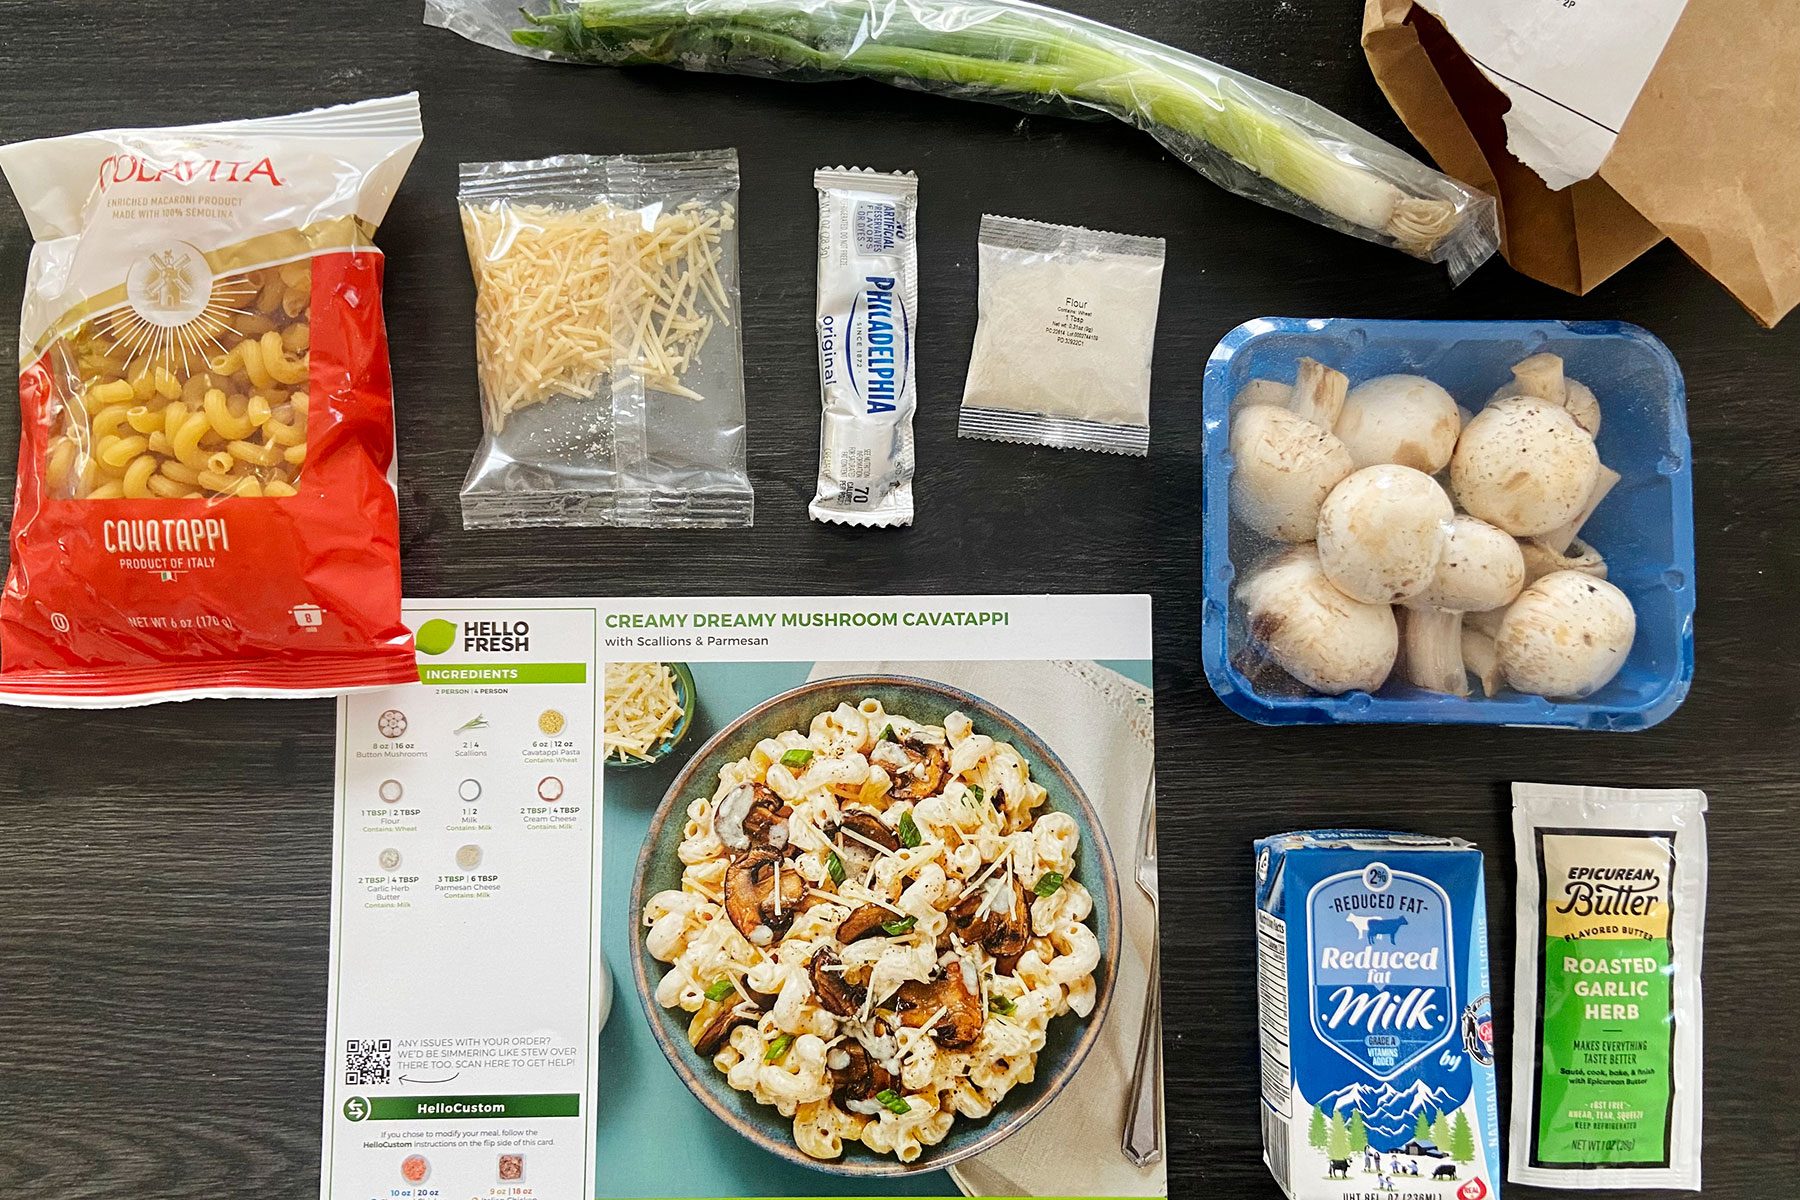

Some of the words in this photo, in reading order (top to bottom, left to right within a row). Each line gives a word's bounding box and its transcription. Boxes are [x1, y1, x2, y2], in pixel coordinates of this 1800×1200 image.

[1563, 0, 1576, 8] 2P
[107, 199, 149, 208] ENRICHED
[151, 197, 195, 206] MACARONI
[199, 196, 243, 206] PRODUCT
[113, 211, 136, 220] MADE
[139, 210, 160, 219] WITH
[162, 209, 184, 218] 100%
[186, 208, 233, 218] SEMOLINA
[858, 211, 865, 222] OR
[857, 224, 865, 242] DYES
[866, 205, 874, 250] FLAVORS
[874, 203, 883, 253] PRESERVATIVES
[884, 206, 895, 249] ARTIFICIAL
[896, 222, 906, 238] NO
[1066, 298, 1087, 308] Flour
[1071, 315, 1085, 324] Tbsp
[821, 315, 837, 385] original
[866, 276, 896, 414] PHILADELPHIA
[854, 487, 869, 503] 70
[103, 519, 229, 553] CAVATAPPI
[120, 558, 167, 569] PRODUCT
[171, 558, 185, 568] OF
[187, 557, 215, 568] ITALY
[128, 617, 148, 628] NET
[150, 618, 167, 628] WT
[171, 617, 177, 629] 6
[179, 619, 193, 628] oz
[196, 616, 220, 628] (170
[222, 616, 232, 631] g)
[304, 612, 313, 624] 8
[605, 614, 688, 628] CREAMY
[693, 613, 776, 628] DREAMY
[781, 613, 897, 627] MUSHROOM
[903, 612, 1009, 627] CAVATAPPI
[464, 621, 529, 636] HELLO
[464, 637, 529, 652] FRESH
[605, 636, 634, 647] with
[637, 635, 692, 646] Scallions
[696, 636, 705, 647] &
[708, 635, 769, 646] Parmesan
[426, 669, 518, 679] INGREDIENTS
[533, 740, 538, 748] 6
[356, 751, 383, 759] Button
[455, 750, 488, 758] Scallions
[522, 749, 560, 758] Cavatappi
[561, 749, 581, 757] Pasta
[1369, 870, 1386, 884] 2%
[1568, 868, 1654, 880] EPICUREAN
[367, 885, 390, 893] Garlic
[391, 885, 410, 893] Herb
[377, 894, 401, 902] Butter
[1556, 877, 1660, 916] Butter
[1564, 926, 1619, 942] FLAVORED
[1622, 927, 1653, 942] BUTTER
[1322, 947, 1439, 970] Reduced
[1564, 957, 1657, 974] ROASTED
[1367, 969, 1390, 983] fat
[1575, 982, 1648, 996] GARLIC
[1329, 986, 1437, 1033] Milk
[1585, 1005, 1640, 1019] HERB
[398, 1040, 419, 1048] ANY
[420, 1039, 454, 1048] ISSUES
[456, 1039, 482, 1047] WITH
[483, 1038, 510, 1047] YOUR
[512, 1037, 552, 1046] ORDER?
[1369, 1036, 1388, 1045] GRADE
[1390, 1036, 1397, 1046] A
[1574, 1041, 1599, 1051] MAKES
[1603, 1041, 1647, 1051] EVERYTHING
[398, 1050, 424, 1059] WE'D
[426, 1050, 439, 1058] BE
[441, 1049, 497, 1058] SIMMERING
[499, 1049, 520, 1057] LIKE
[521, 1048, 549, 1057] STEW
[551, 1047, 577, 1056] OVER
[1368, 1048, 1398, 1057] VITAMINS
[398, 1061, 430, 1070] THERE
[431, 1061, 454, 1070] TOO.
[456, 1060, 482, 1069] SCAN
[484, 1060, 510, 1068] HERE
[512, 1060, 526, 1068] TO
[527, 1059, 546, 1068] GET
[548, 1059, 576, 1067] HELP!
[1373, 1057, 1394, 1066] ADDED
[1439, 1050, 1461, 1071] by
[1585, 1054, 1607, 1064] TASTE
[1610, 1054, 1636, 1064] BETTER
[1560, 1068, 1586, 1076] Sauté,
[1587, 1069, 1608, 1077] cook,
[1609, 1069, 1629, 1077] bake,
[1587, 1078, 1625, 1087] Epicurean
[1626, 1078, 1648, 1086] Butter
[418, 1103, 505, 1114] HelloCustom
[1486, 1073, 1496, 1148] NATURALLY
[381, 1131, 387, 1139] If
[435, 1130, 462, 1139] modify
[463, 1131, 479, 1139] your
[480, 1129, 500, 1138] meal,
[502, 1129, 525, 1137] follow
[526, 1129, 539, 1137] the
[363, 1141, 413, 1149] HelloCustom
[484, 1140, 496, 1148] flip
[497, 1139, 513, 1147] side
[514, 1139, 523, 1147] of
[522, 1139, 536, 1147] this
[1572, 1140, 1586, 1150] NET
